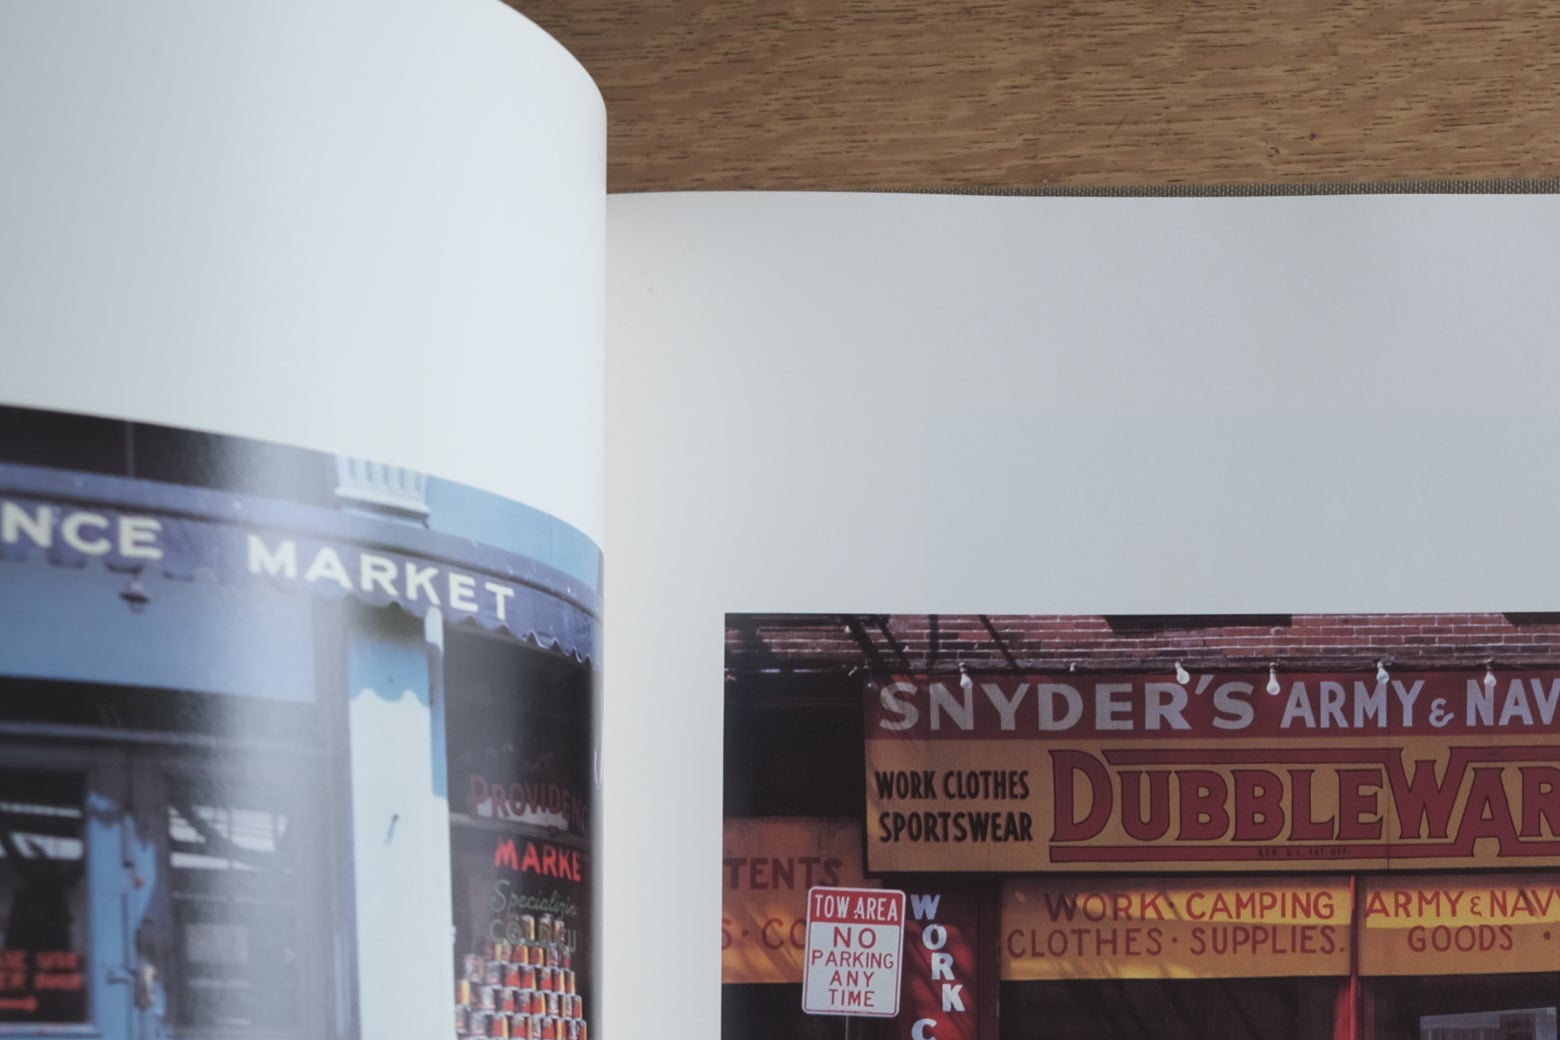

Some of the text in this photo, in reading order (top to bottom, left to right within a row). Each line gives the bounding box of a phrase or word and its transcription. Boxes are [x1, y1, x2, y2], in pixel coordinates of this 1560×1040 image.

[247, 534, 515, 621] MARKET
[879, 675, 1254, 731] SNYDER'S
[1280, 679, 1425, 728] ARMY
[1428, 698, 1454, 728] &
[875, 770, 1030, 800] WORK CLOTHES
[879, 811, 1033, 843] SPORTSWEAR
[723, 857, 842, 890] TENTS
[815, 894, 898, 922] TOW AREA
[1044, 891, 1335, 922] WORK CAMPING
[1365, 890, 1464, 917] ARMY
[833, 926, 876, 949] NO
[1007, 927, 1163, 959] CLOTHES
[1407, 924, 1513, 952] GOODS
[812, 949, 894, 970] PARKING
[911, 895, 966, 1012] WORK
[829, 969, 875, 988] ANY
[828, 988, 875, 1008] TIME
